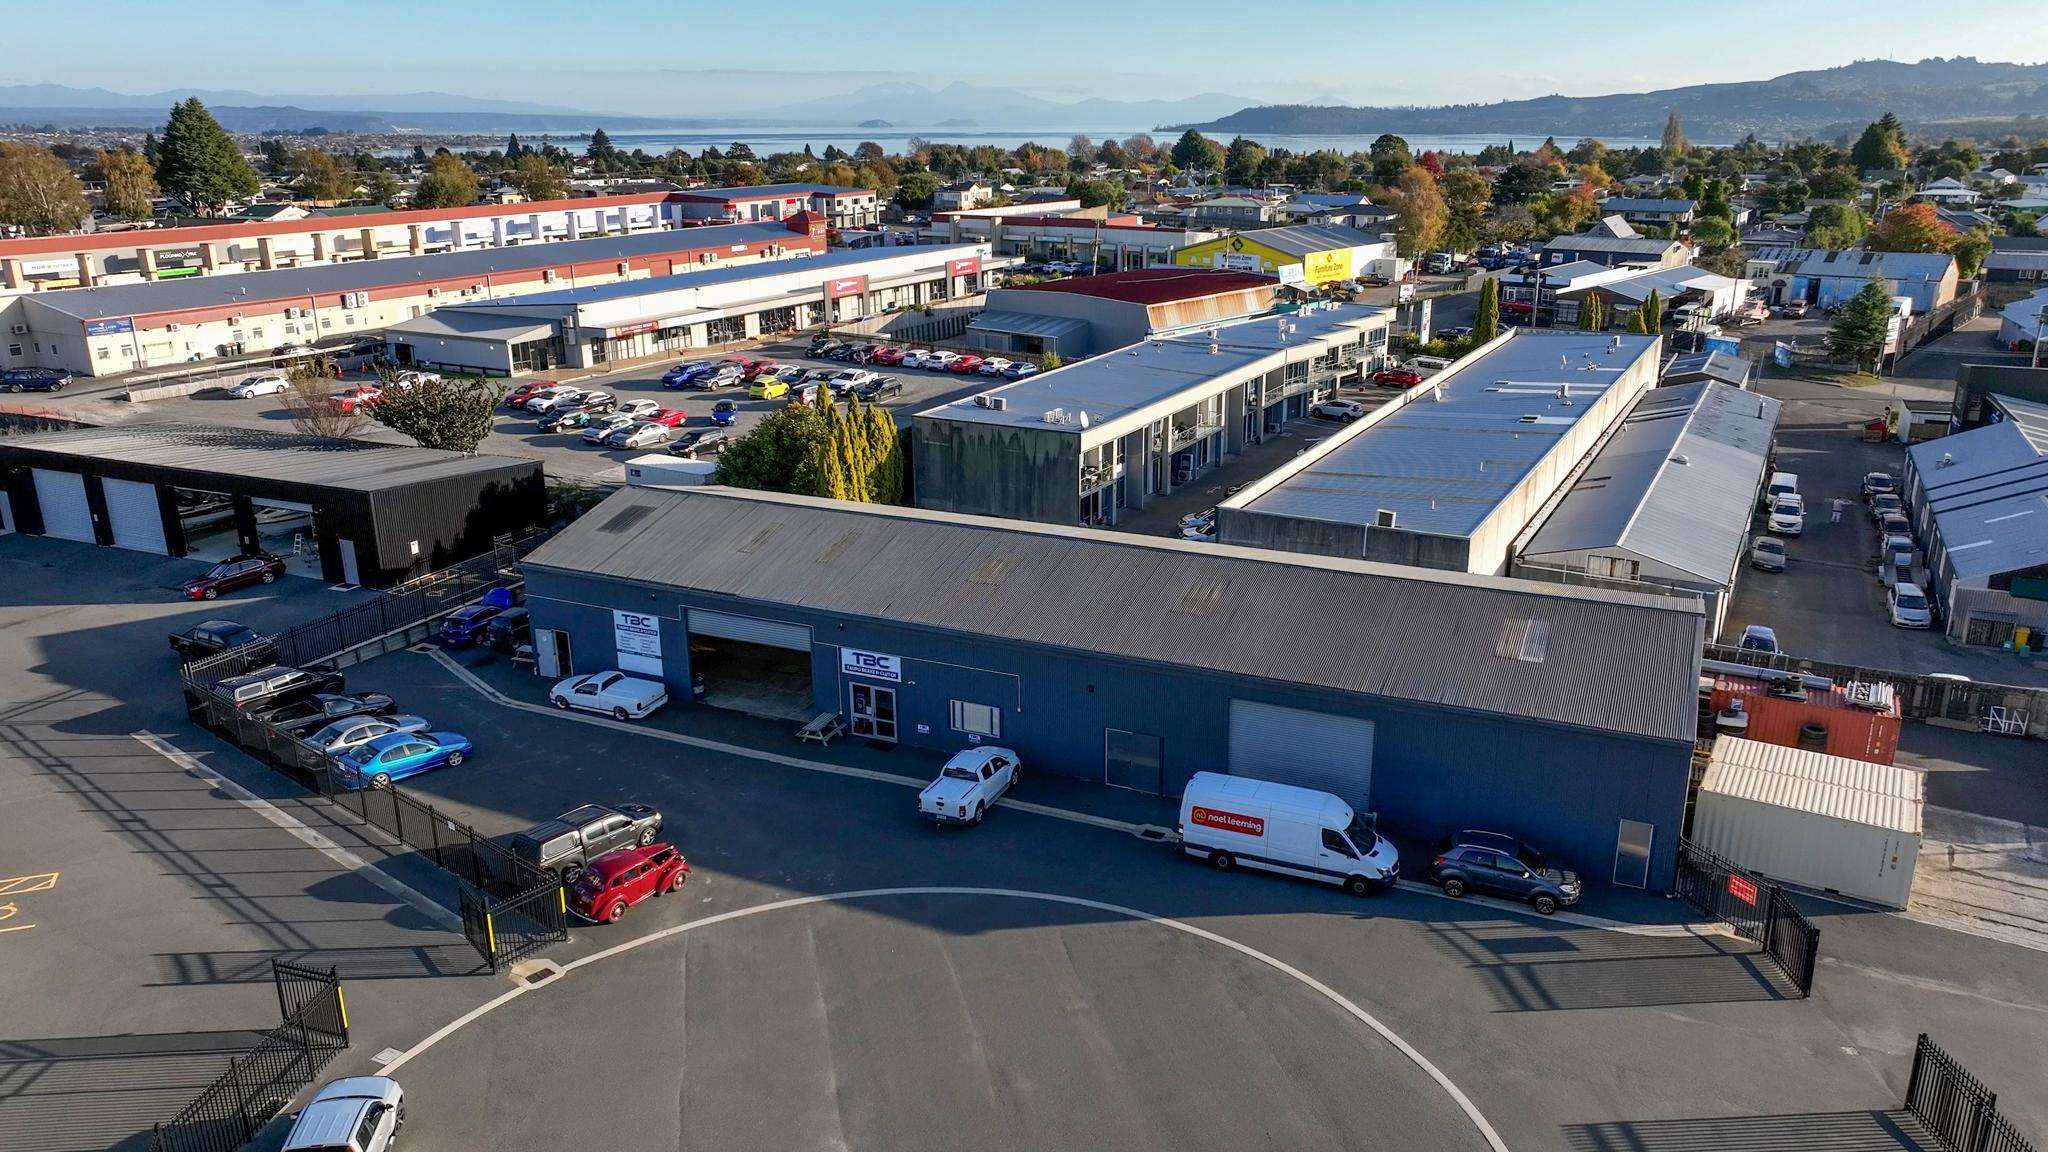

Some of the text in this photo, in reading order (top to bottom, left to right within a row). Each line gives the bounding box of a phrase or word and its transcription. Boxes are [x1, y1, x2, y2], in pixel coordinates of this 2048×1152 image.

[621, 614, 651, 628] TBC
[852, 651, 891, 669] TBC
[879, 670, 897, 678] CLUTCH
[1208, 814, 1227, 824] noel
[1227, 816, 1262, 833] leeming
